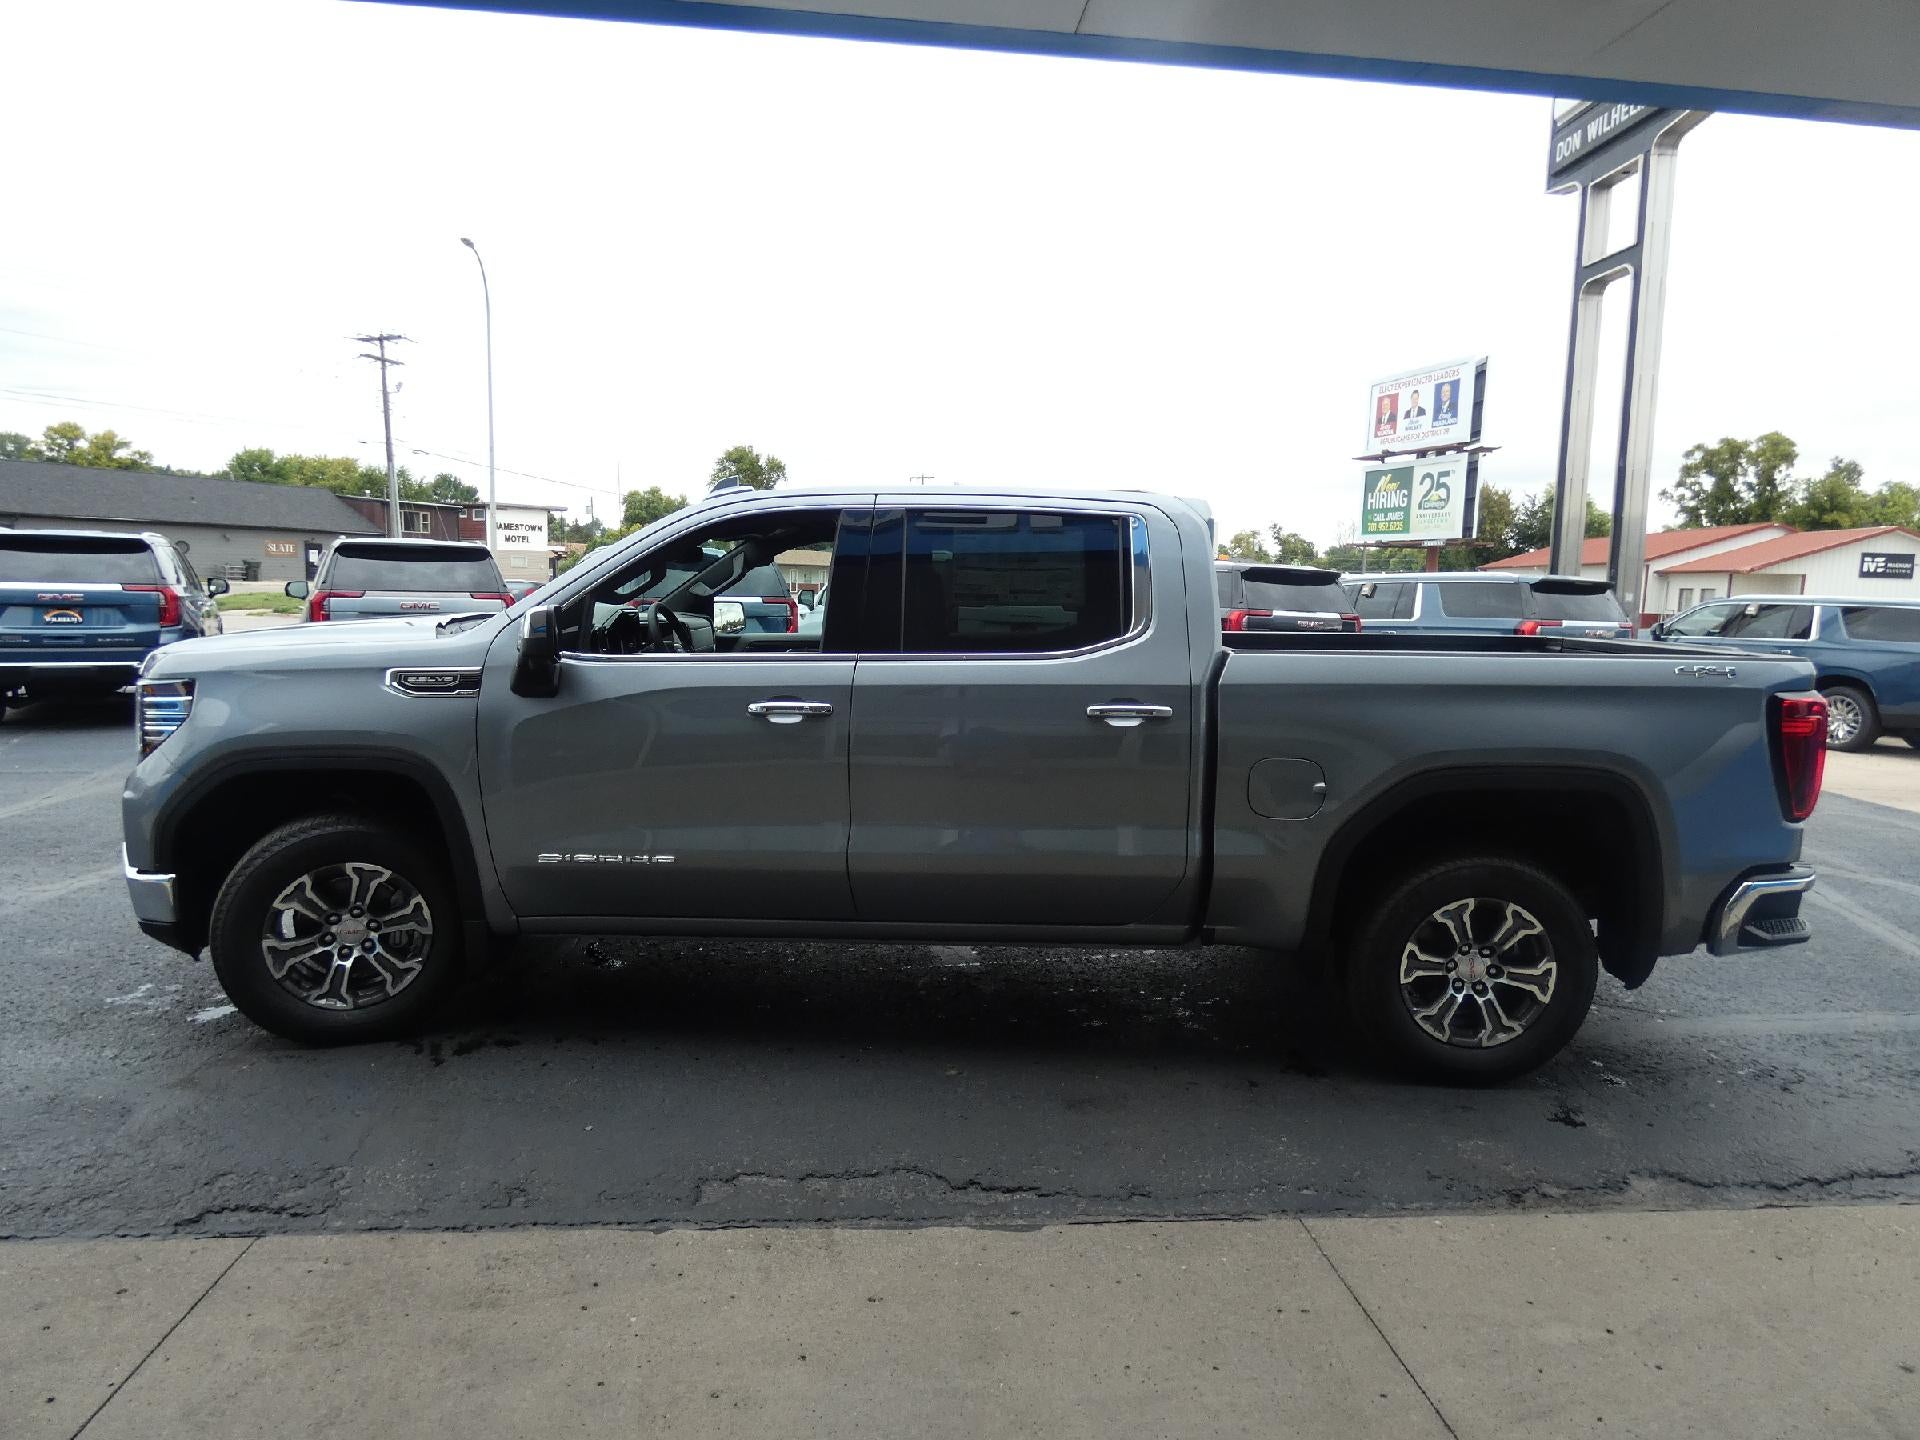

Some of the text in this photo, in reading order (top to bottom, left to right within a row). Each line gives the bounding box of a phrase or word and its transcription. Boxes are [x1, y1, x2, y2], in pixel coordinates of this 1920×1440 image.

[1556, 103, 1646, 163] DON WILHEL
[1433, 368, 1460, 381] LEADERS
[1418, 470, 1450, 510] 25
[1367, 489, 1408, 510] HIRING
[504, 534, 531, 543] MOTEL
[267, 543, 296, 553] SLATE
[37, 593, 84, 601] GMC
[400, 602, 440, 610] GMC
[538, 853, 675, 864] SIERRA
